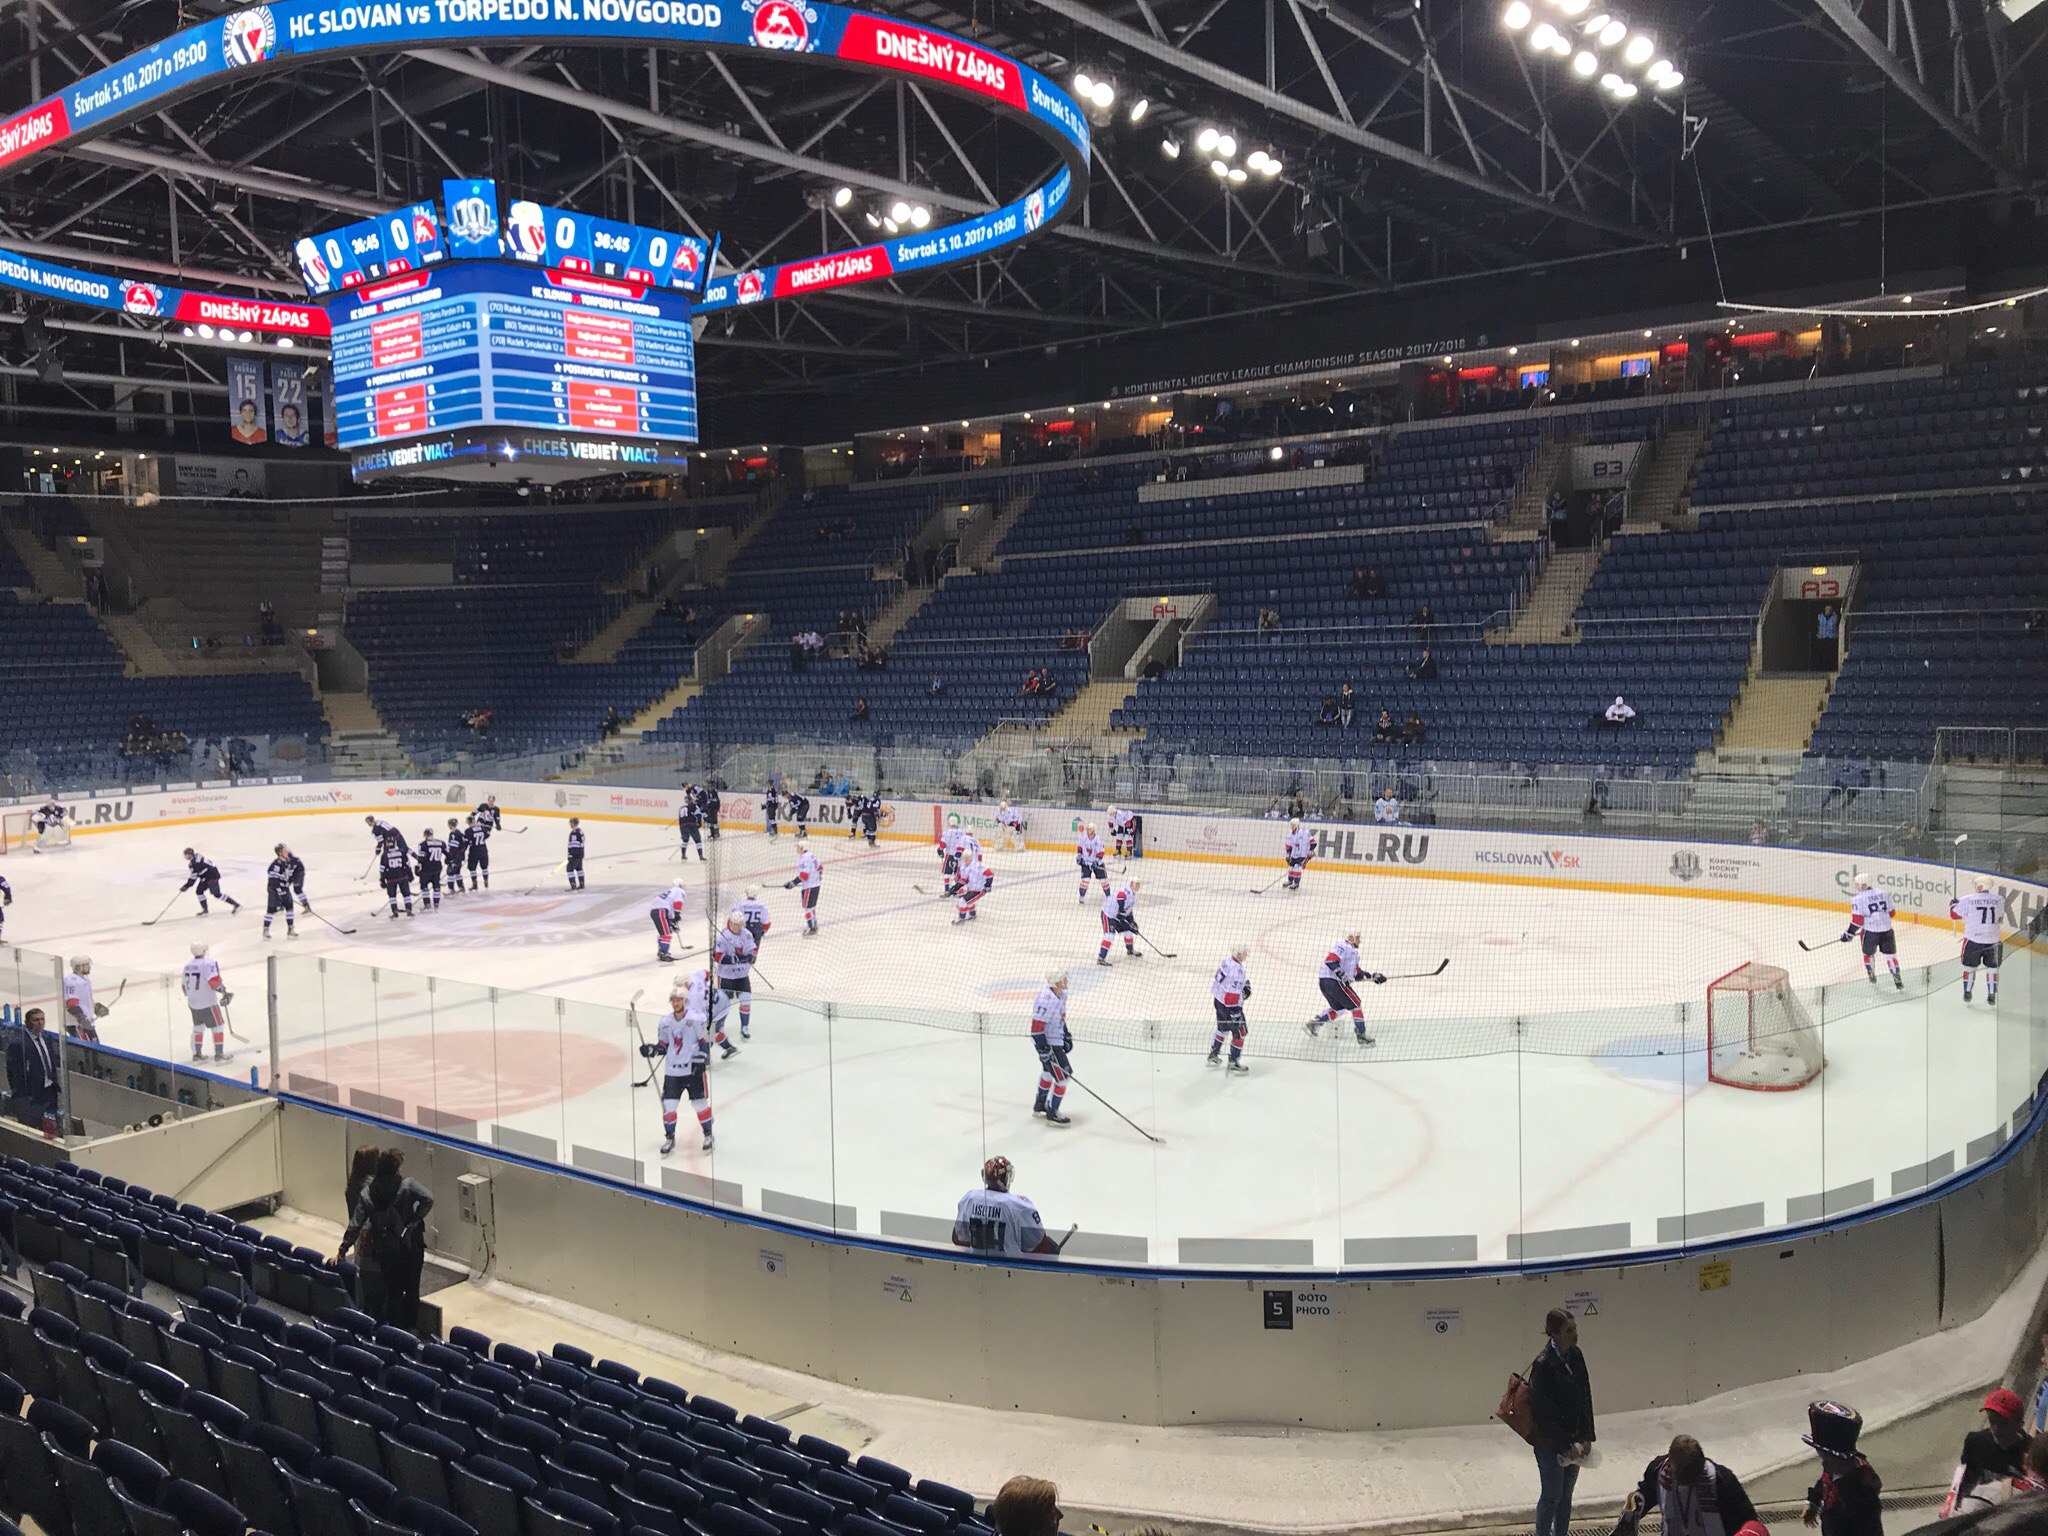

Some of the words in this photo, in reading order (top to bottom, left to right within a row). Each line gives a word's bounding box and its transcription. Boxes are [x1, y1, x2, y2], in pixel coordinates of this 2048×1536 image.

[289, 13, 315, 38] HC
[319, 3, 402, 34] SLOVAN
[406, 5, 431, 24] vs
[435, 0, 549, 22] TORPEDO
[554, 0, 579, 20] N.
[583, 0, 722, 28] NOVGOROD
[876, 29, 954, 72] DNEŠNÝ
[956, 52, 1005, 90] ZÁPAS
[74, 86, 111, 118] Štvrtok
[112, 83, 122, 100] 5.
[122, 76, 138, 95] 10.
[138, 58, 163, 87] 2017
[164, 62, 172, 76] o
[172, 40, 207, 73] 19:00
[21, 112, 53, 146] ZÁPAS
[391, 217, 410, 251] 0
[555, 217, 576, 249] 0
[898, 238, 937, 263] Štvrtok
[938, 238, 948, 252] 5.
[949, 235, 964, 250] 10.
[964, 226, 986, 247] 2017
[993, 214, 1017, 235] 19:00
[325, 238, 343, 270] 0
[649, 236, 668, 268] 0
[31, 269, 43, 285] N.
[43, 271, 109, 300] NOVGOROD
[791, 260, 836, 287] DNEŠNÝ
[836, 255, 873, 281] ZÁPAS
[200, 301, 260, 324] DNEŠNÝ
[261, 306, 309, 328] ZÁPAS
[1124, 377, 1188, 396] KONTINENTAL
[1190, 371, 1228, 386] HOCKEY
[1232, 365, 1271, 379] LEAGUE
[1273, 353, 1355, 375] CHAMPIONSHIP
[1358, 347, 1403, 364] SEASON
[1406, 338, 1466, 357] 2017/2018
[237, 373, 257, 400] 15
[278, 378, 302, 405] 22
[358, 449, 388, 471] CHCEŠ
[388, 442, 423, 467] VEDIEŤ
[424, 441, 454, 463] VIAC?
[523, 437, 568, 457] CHCEŠ
[569, 441, 619, 461] VEDIEŤ
[619, 446, 659, 465] VIAC?
[1801, 580, 1840, 599] A3
[1152, 604, 1177, 619] A4
[625, 798, 669, 809] BRATISLAVA
[428, 847, 442, 862] 70
[1475, 850, 1543, 866] HCSLOVAN
[1709, 857, 1762, 867] KONTINENTAL
[1709, 865, 1741, 874] HOCKEY
[1709, 873, 1739, 881] LEAGUE
[1877, 872, 1952, 896] cashback
[1975, 906, 1996, 925] 71
[1273, 1301, 1283, 1316] 5
[1296, 1306, 1330, 1316] PHOTO
[1298, 1293, 1328, 1303] ФОТО
